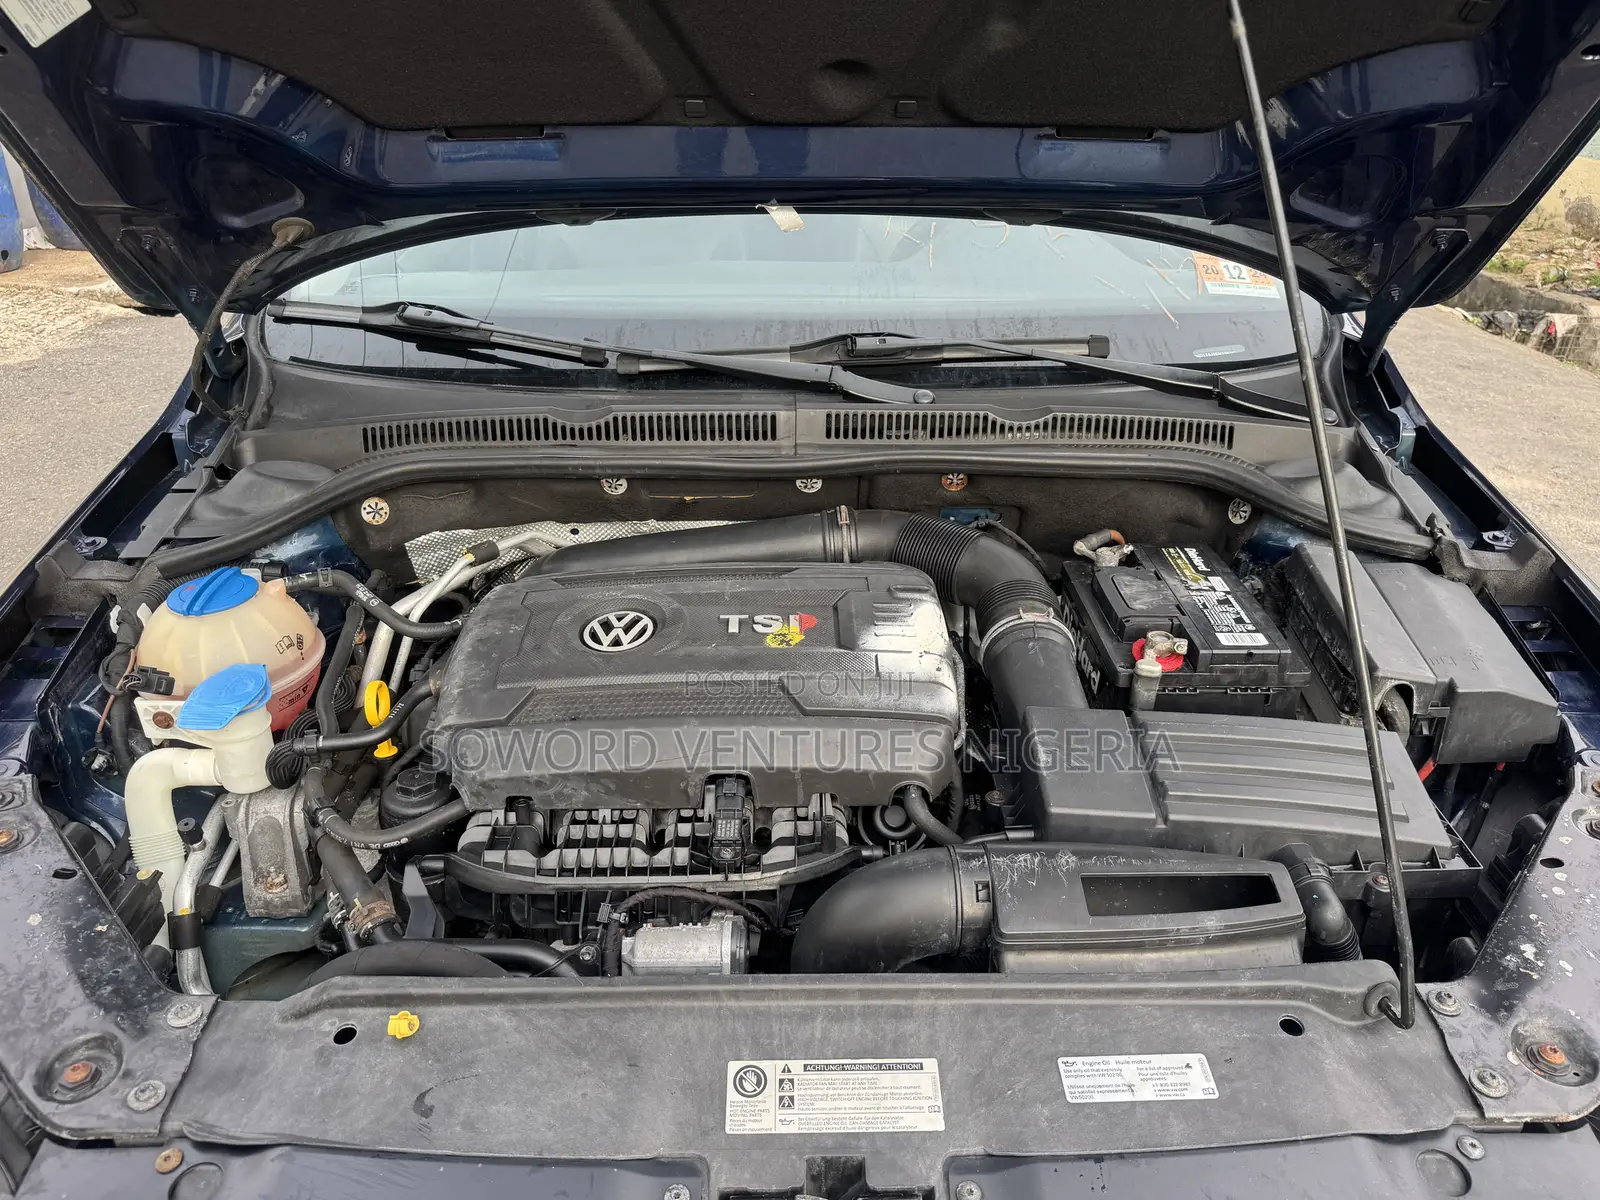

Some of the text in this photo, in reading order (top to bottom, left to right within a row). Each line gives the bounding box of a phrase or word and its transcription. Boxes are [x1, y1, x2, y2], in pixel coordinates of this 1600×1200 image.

[1203, 264, 1219, 275] 20
[1223, 264, 1246, 280] 12
[1184, 547, 1211, 571] DieHard
[719, 614, 800, 633] TSI
[288, 693, 300, 704] min
